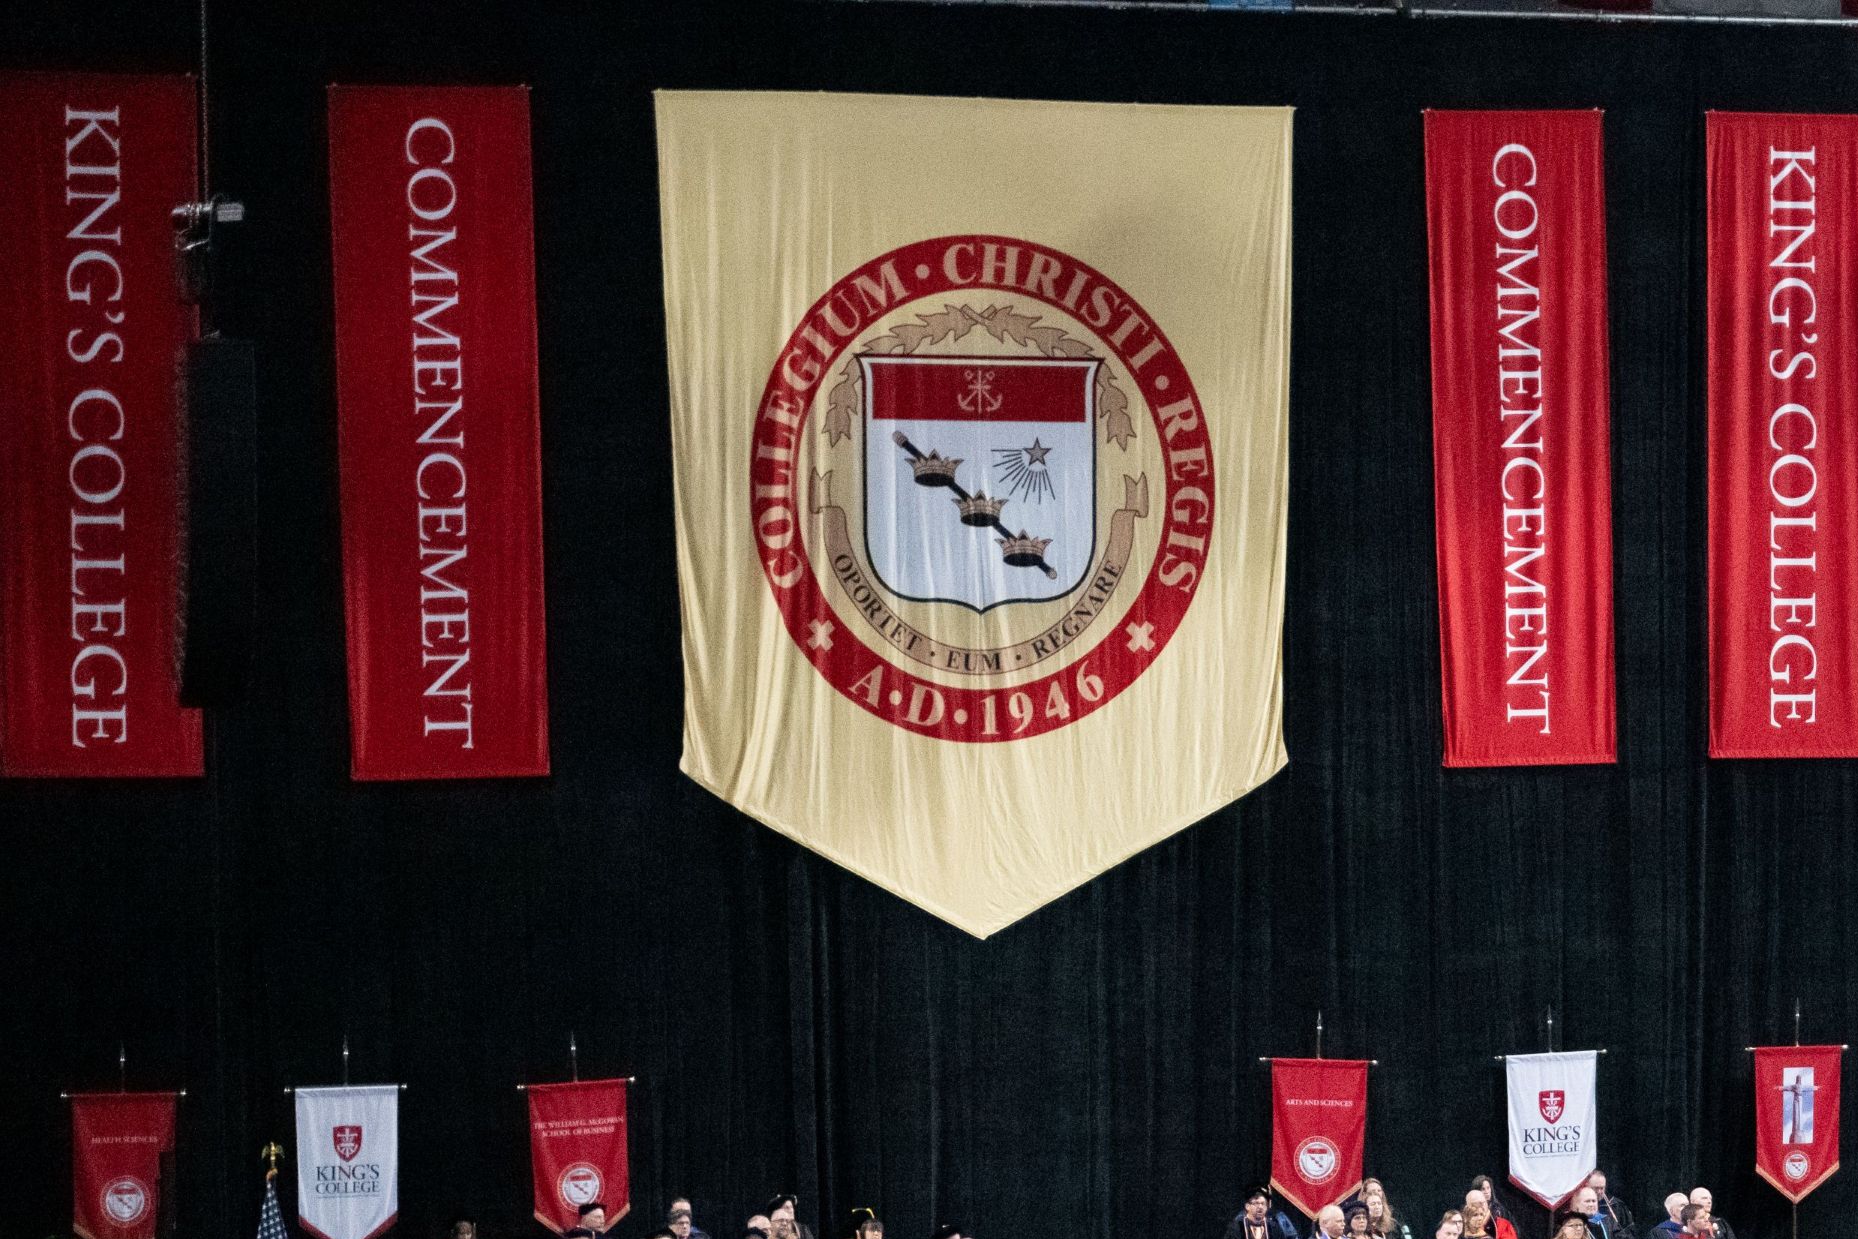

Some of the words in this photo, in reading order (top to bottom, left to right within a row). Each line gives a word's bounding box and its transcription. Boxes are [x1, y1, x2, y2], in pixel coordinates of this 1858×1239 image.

[65, 105, 124, 364] KING'S
[1768, 146, 1818, 382] KING'S
[405, 116, 474, 749] COMMENCEMENT
[756, 257, 912, 591] COLLEGIUM
[941, 241, 1168, 377] CHRISTI
[1154, 392, 1212, 594] REGIS
[1491, 142, 1551, 735] COMMENCEMENT
[68, 389, 127, 748] COLLEGE
[834, 553, 923, 651] OPORTET
[946, 651, 1001, 671] EUM
[1031, 559, 1122, 659] REGNARE
[1768, 404, 1818, 728] COLLEGE
[976, 660, 1105, 736] 1946
[315, 1181, 381, 1194] COLLEGE
[316, 1163, 380, 1181] KING'S
[1523, 1125, 1581, 1143] KING'S
[1523, 1141, 1580, 1155] COLLEGE
